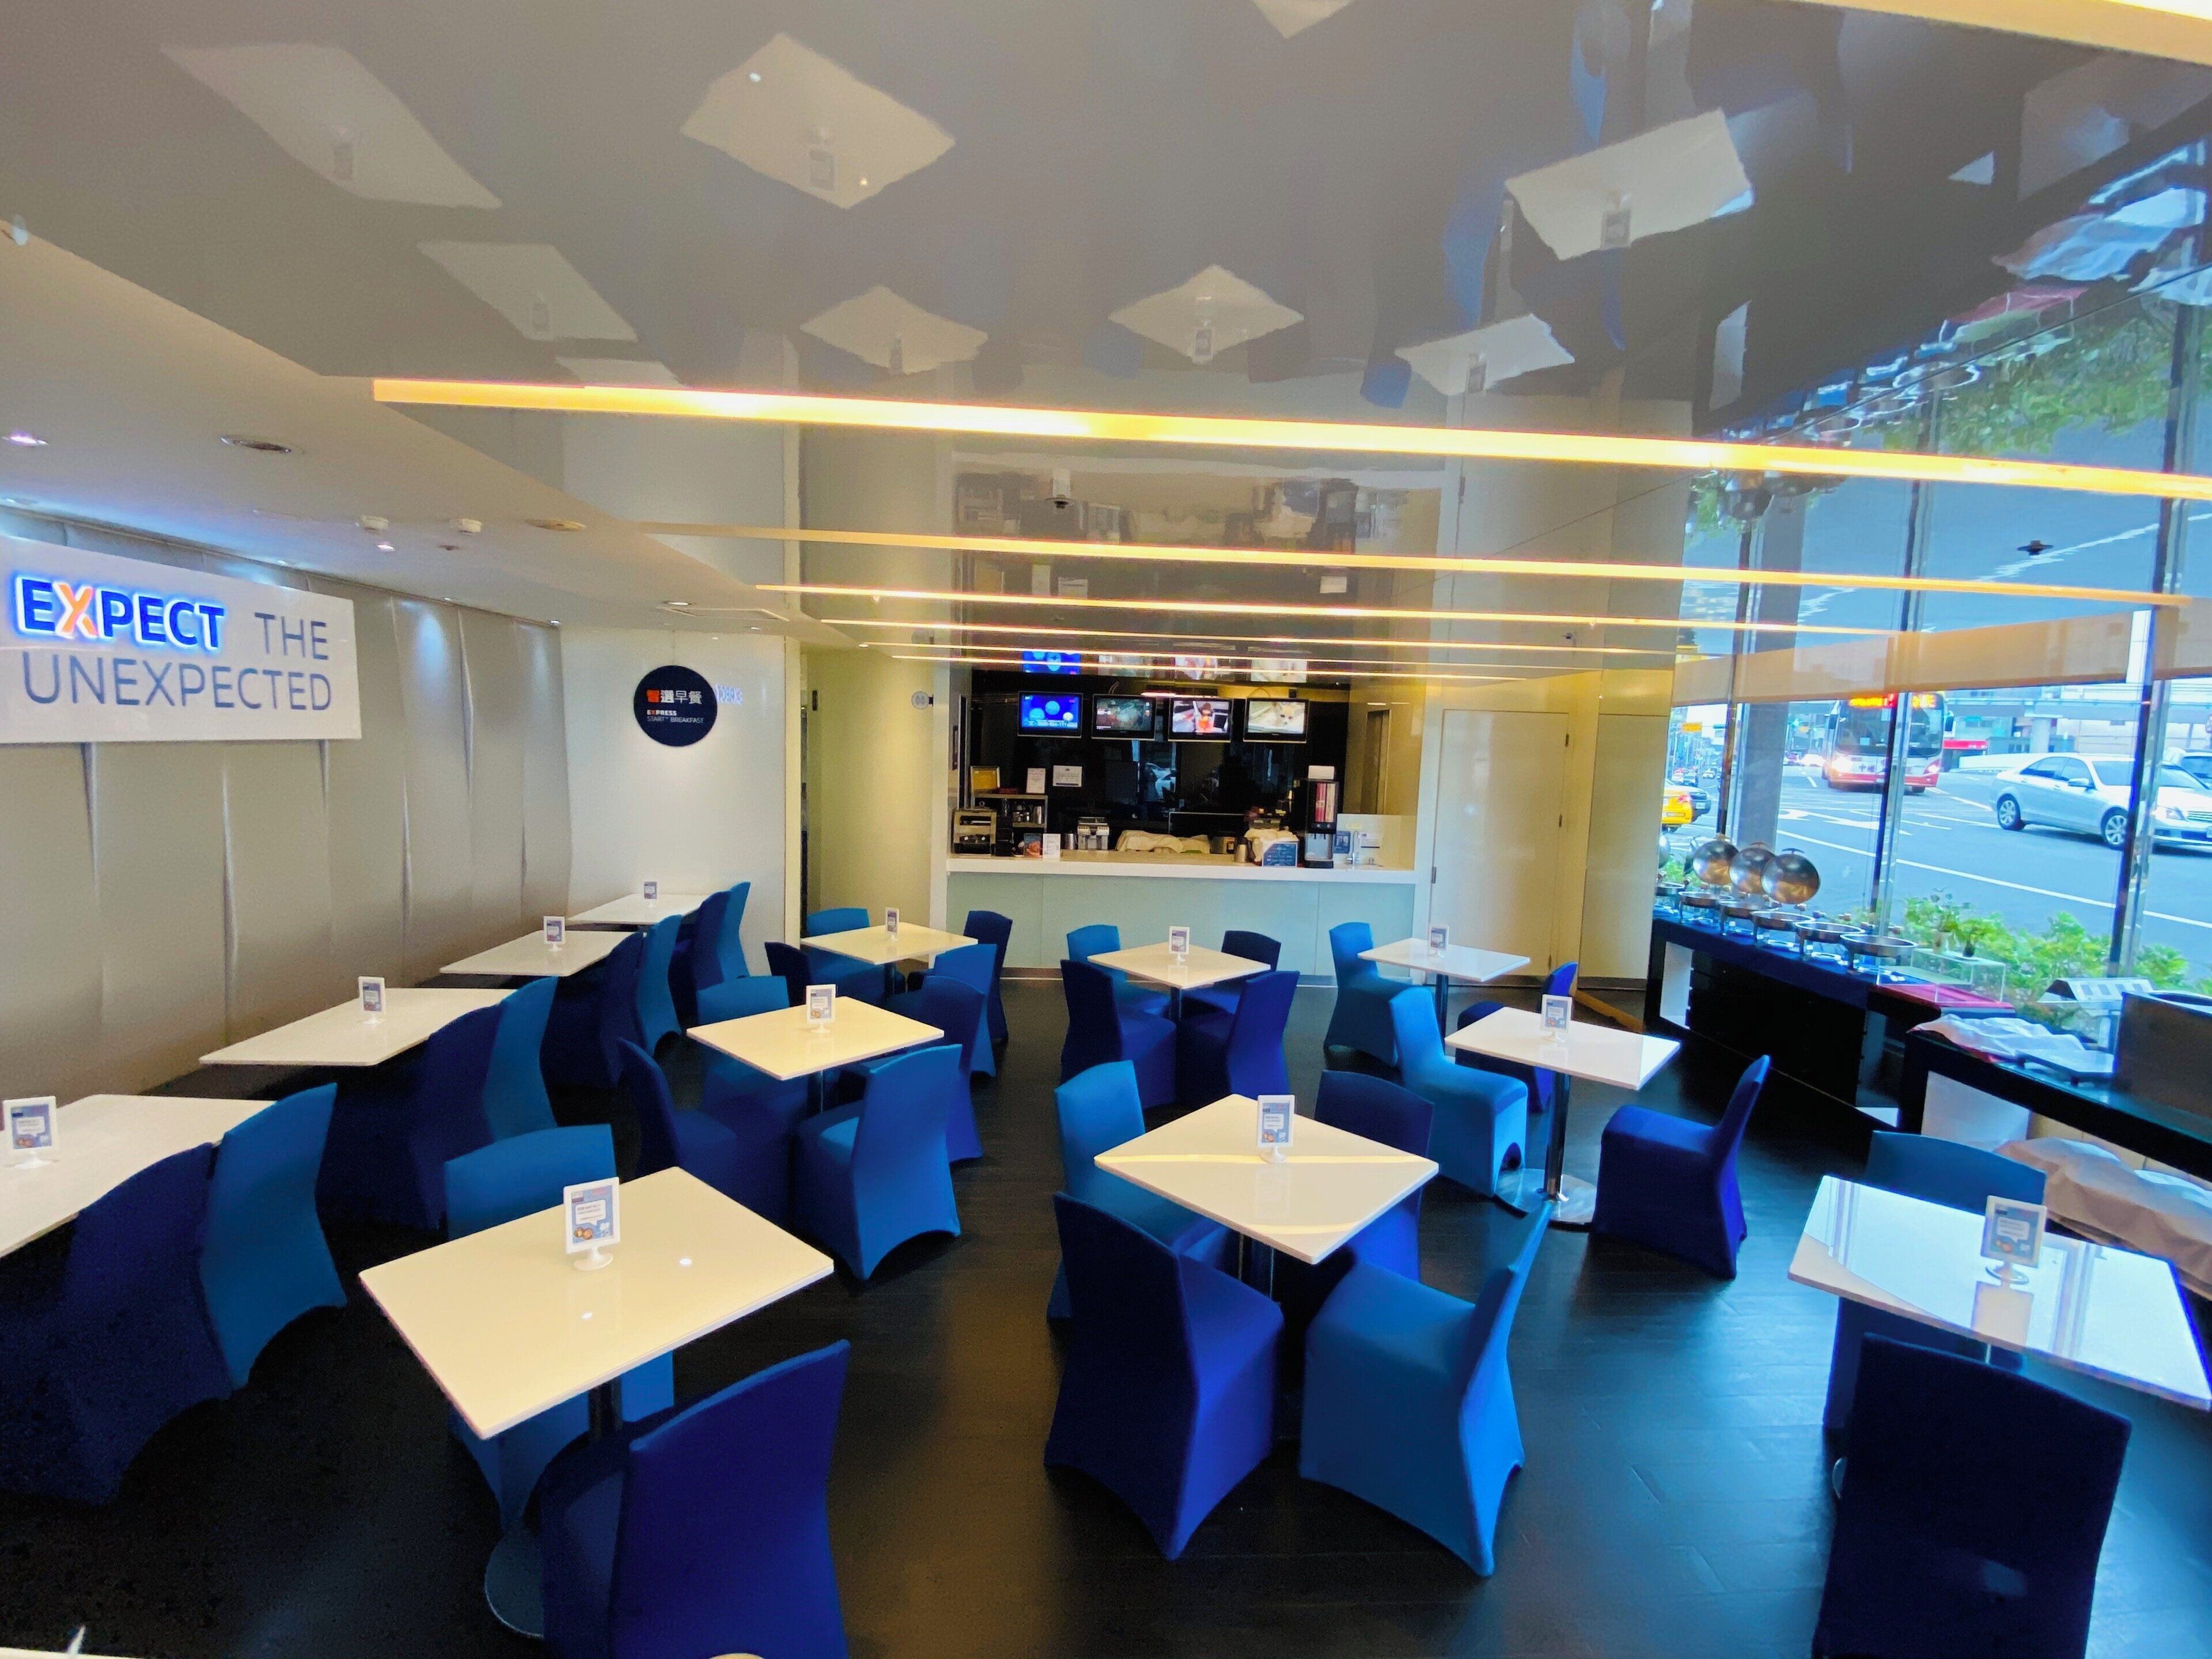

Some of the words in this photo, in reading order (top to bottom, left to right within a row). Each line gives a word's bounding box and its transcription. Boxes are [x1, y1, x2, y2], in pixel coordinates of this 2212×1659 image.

[16, 577, 225, 649] EXPECT
[254, 612, 329, 661] THE
[23, 651, 333, 711] UNEXPECTED
